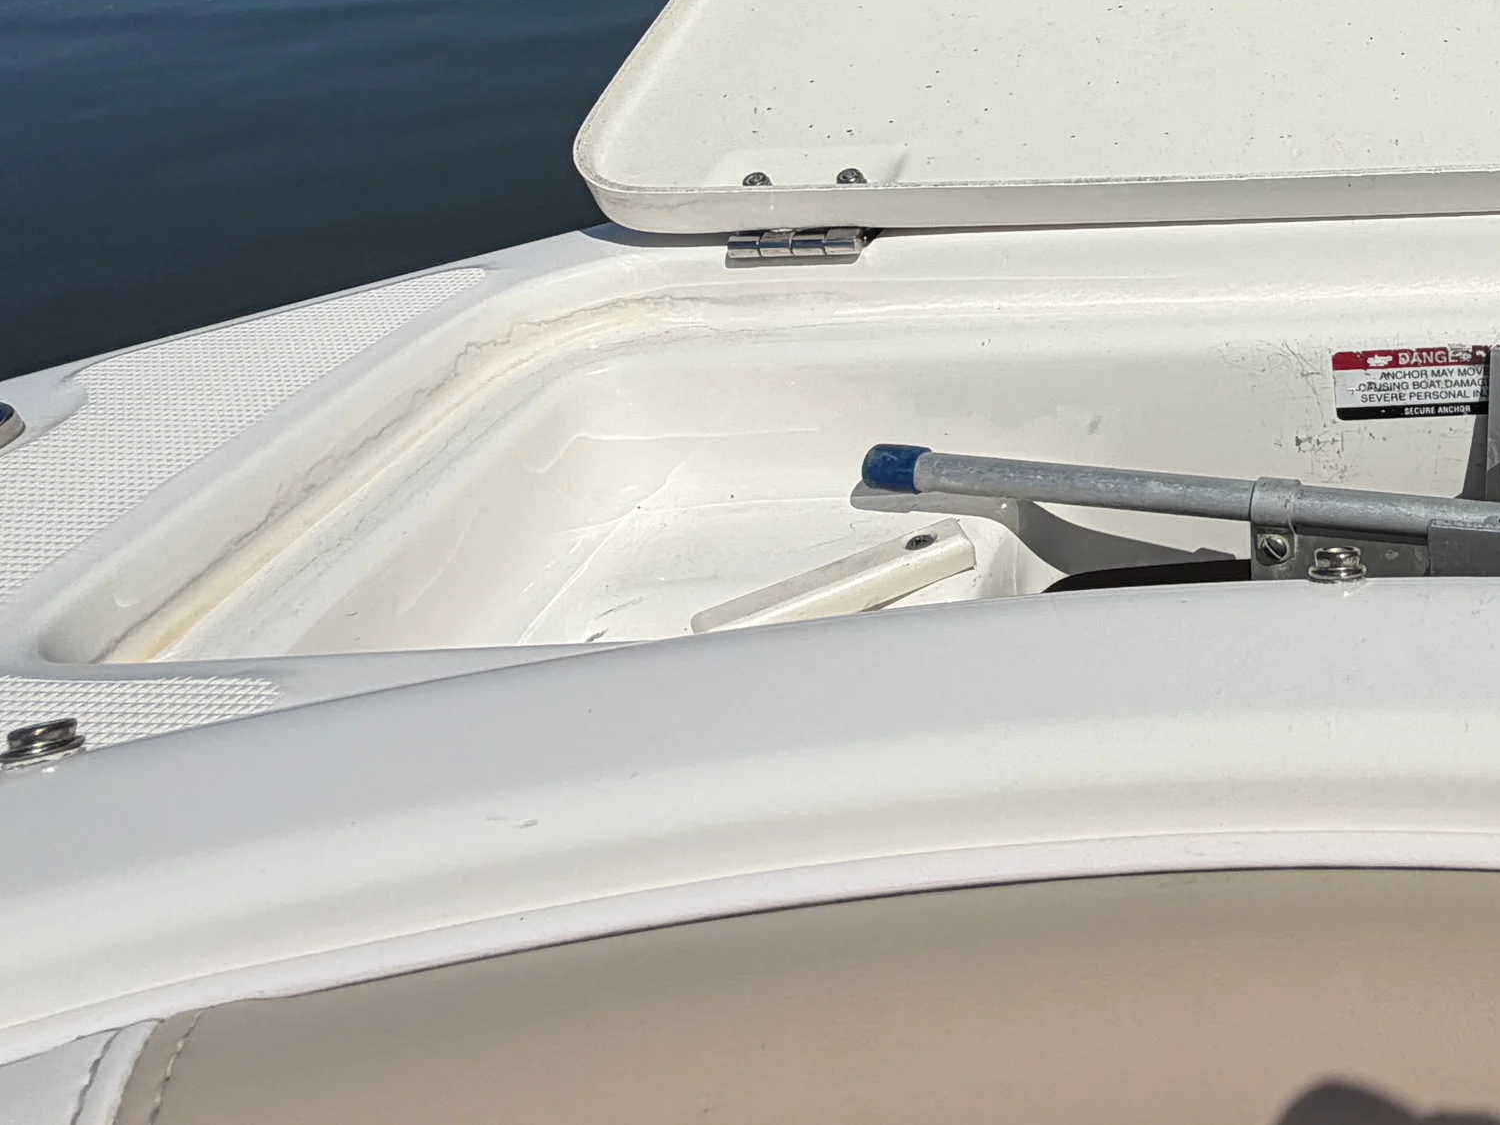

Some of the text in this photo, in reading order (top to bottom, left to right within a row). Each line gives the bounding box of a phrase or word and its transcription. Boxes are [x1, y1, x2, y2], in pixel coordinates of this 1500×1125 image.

[1380, 369, 1427, 380] ANCHOR
[1431, 368, 1454, 378] MAY
[1358, 381, 1409, 393] CAUSING
[1412, 379, 1441, 390] BOAT
[1361, 388, 1489, 403] SEVERE PERSONAL INJ
[1404, 404, 1471, 416] SECURE ANCHOR
